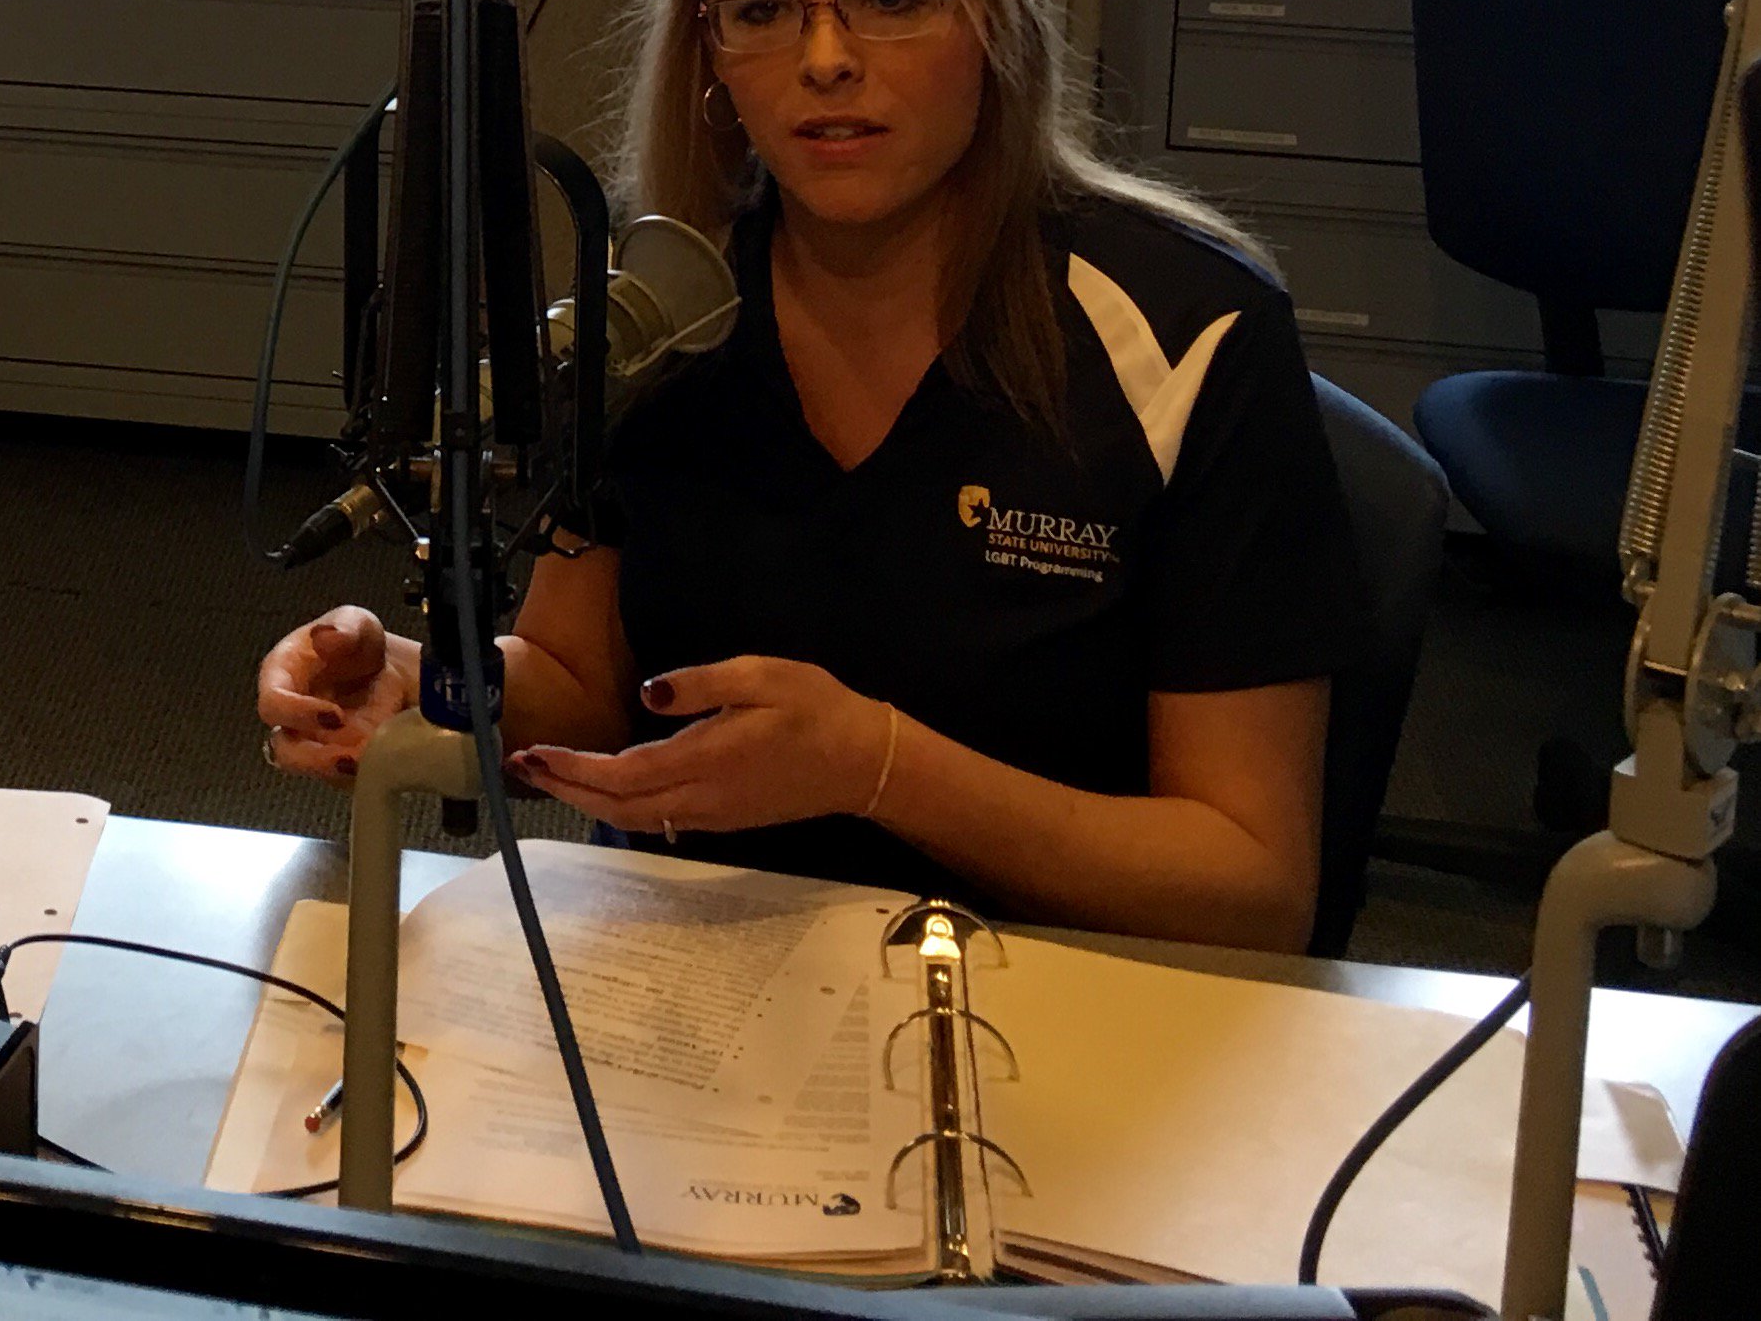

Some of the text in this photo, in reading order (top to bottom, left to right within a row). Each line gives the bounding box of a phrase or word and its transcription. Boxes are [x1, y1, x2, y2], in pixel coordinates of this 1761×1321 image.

[986, 507, 1119, 548] MURRAY
[988, 532, 1111, 562] STATE UNIVERSITY
[985, 549, 1104, 583] LGBT Programming
[681, 1185, 819, 1207] MURRAY
